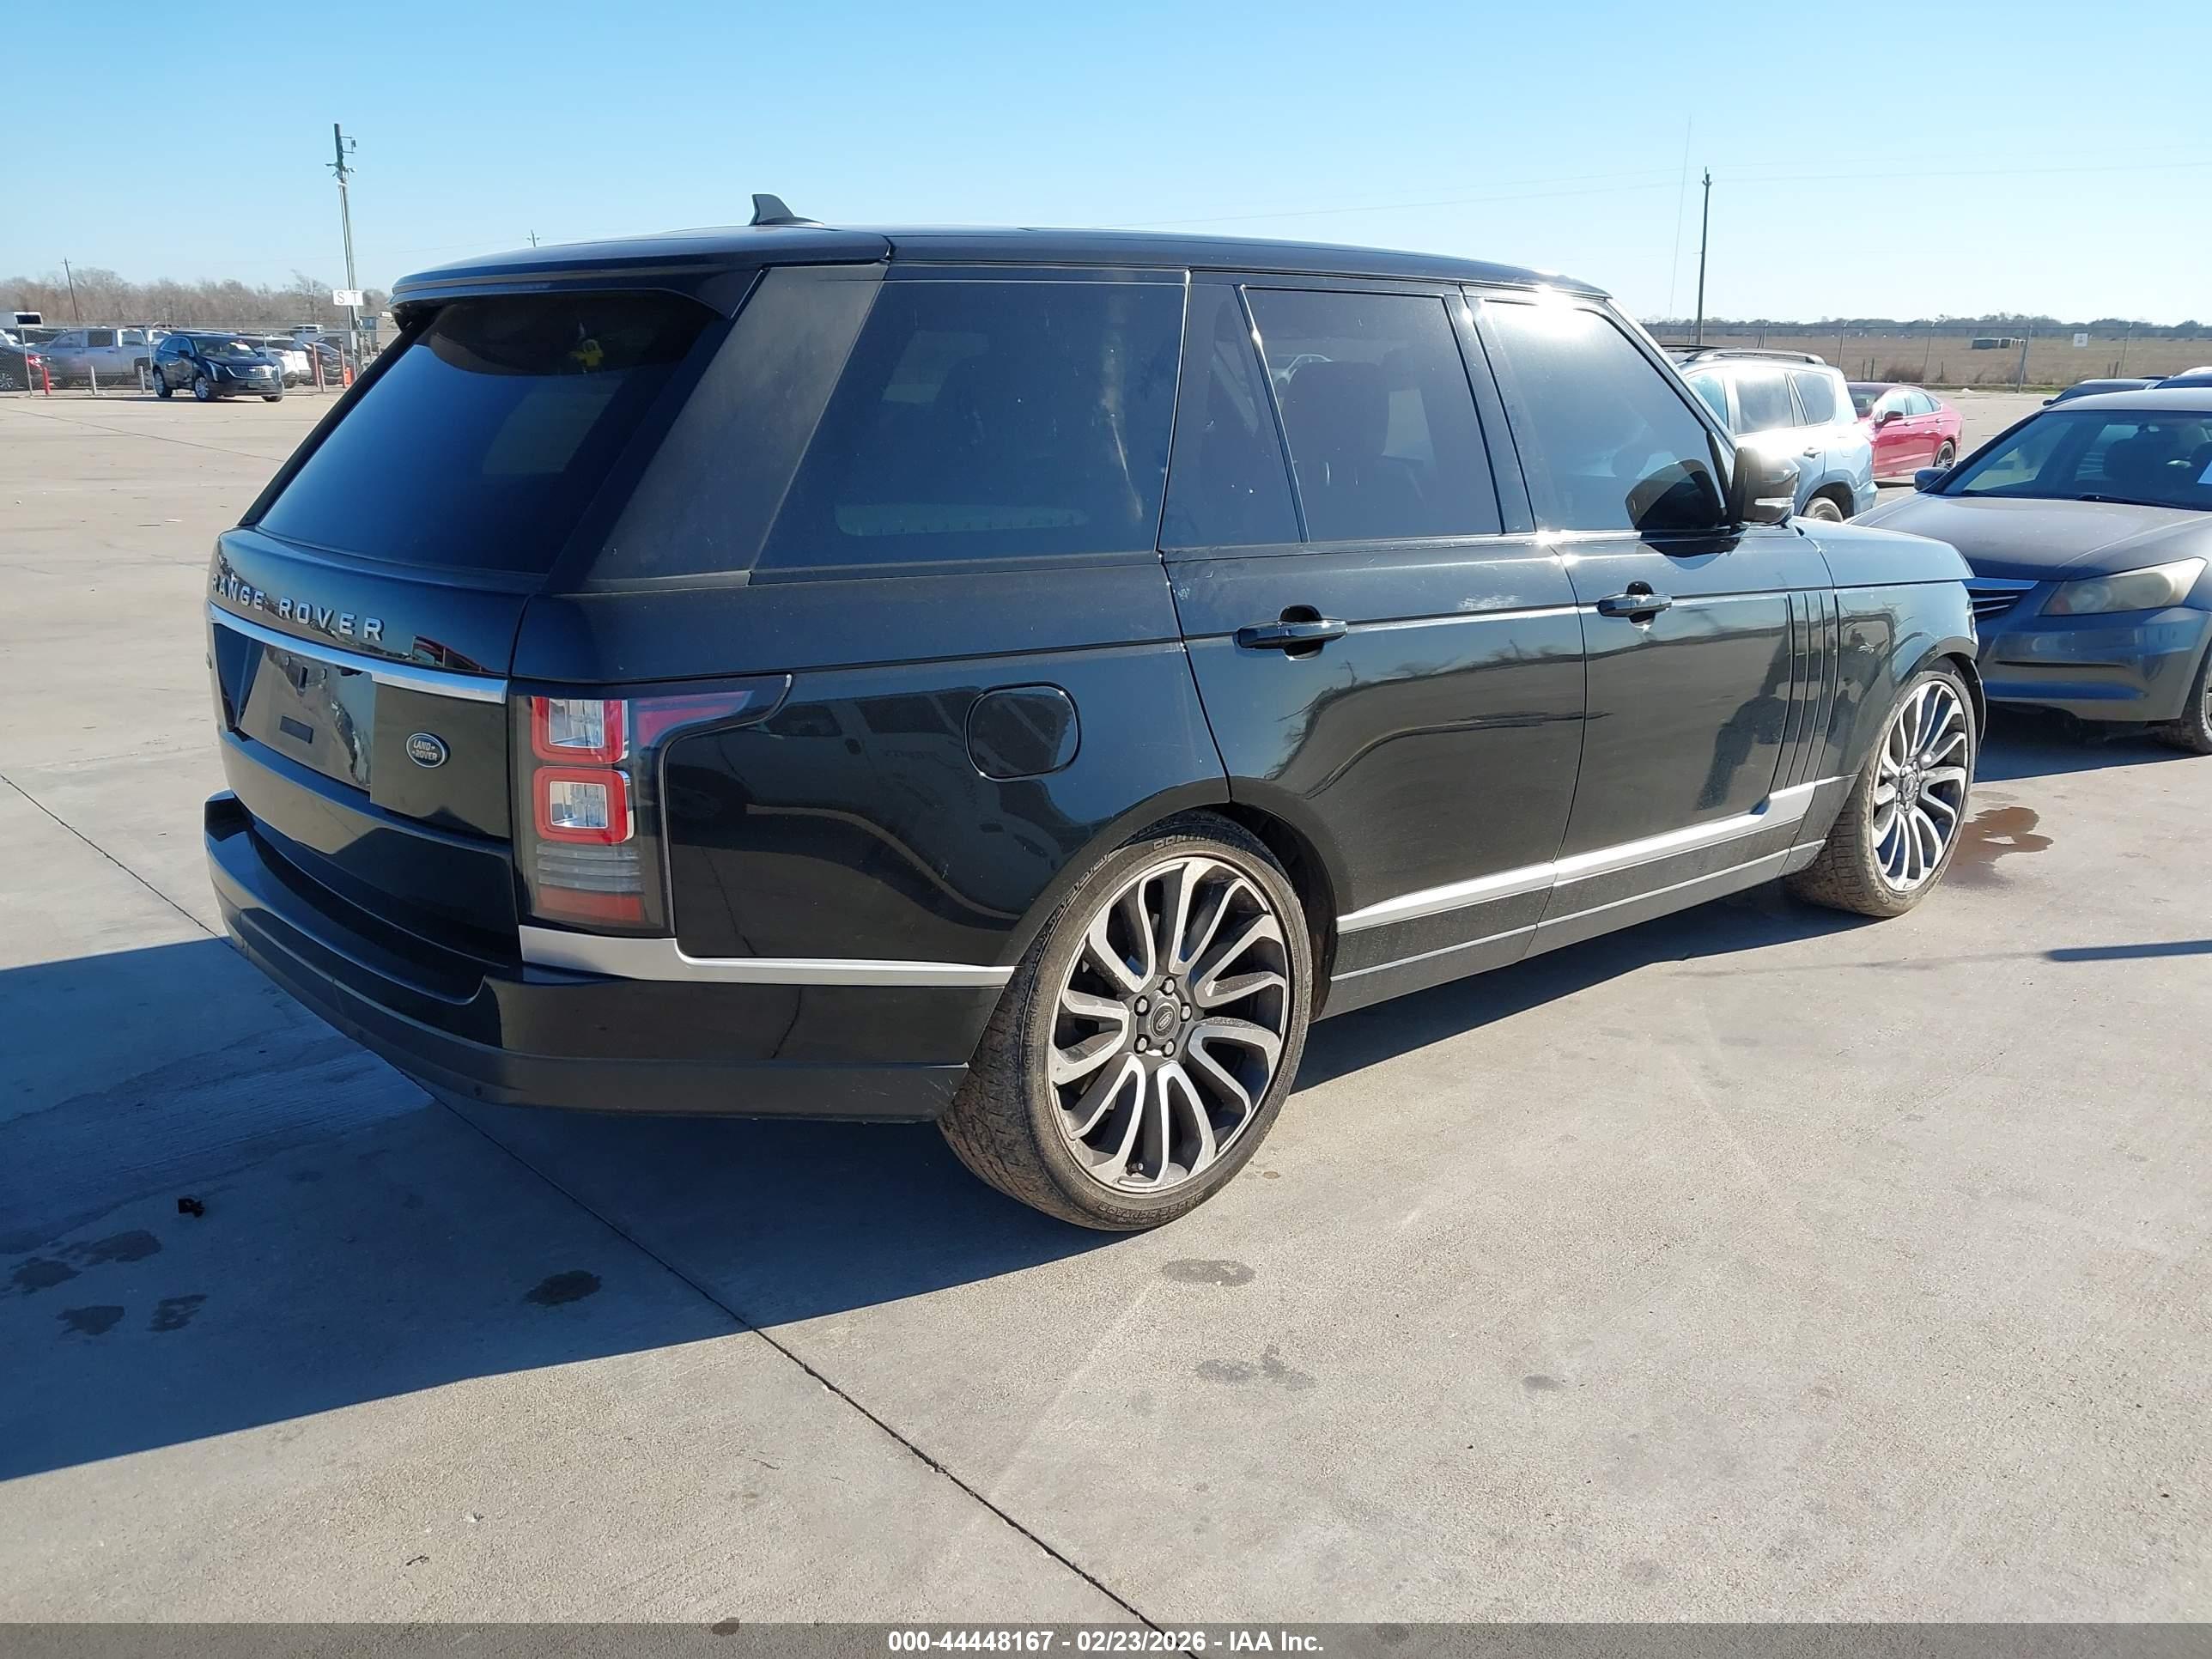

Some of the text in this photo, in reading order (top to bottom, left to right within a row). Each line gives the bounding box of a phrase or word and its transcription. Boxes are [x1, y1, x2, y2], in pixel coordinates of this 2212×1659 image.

[212, 573, 384, 641] RANGE ROVER
[413, 739, 431, 751] LAND
[416, 749, 438, 761] ROVER
